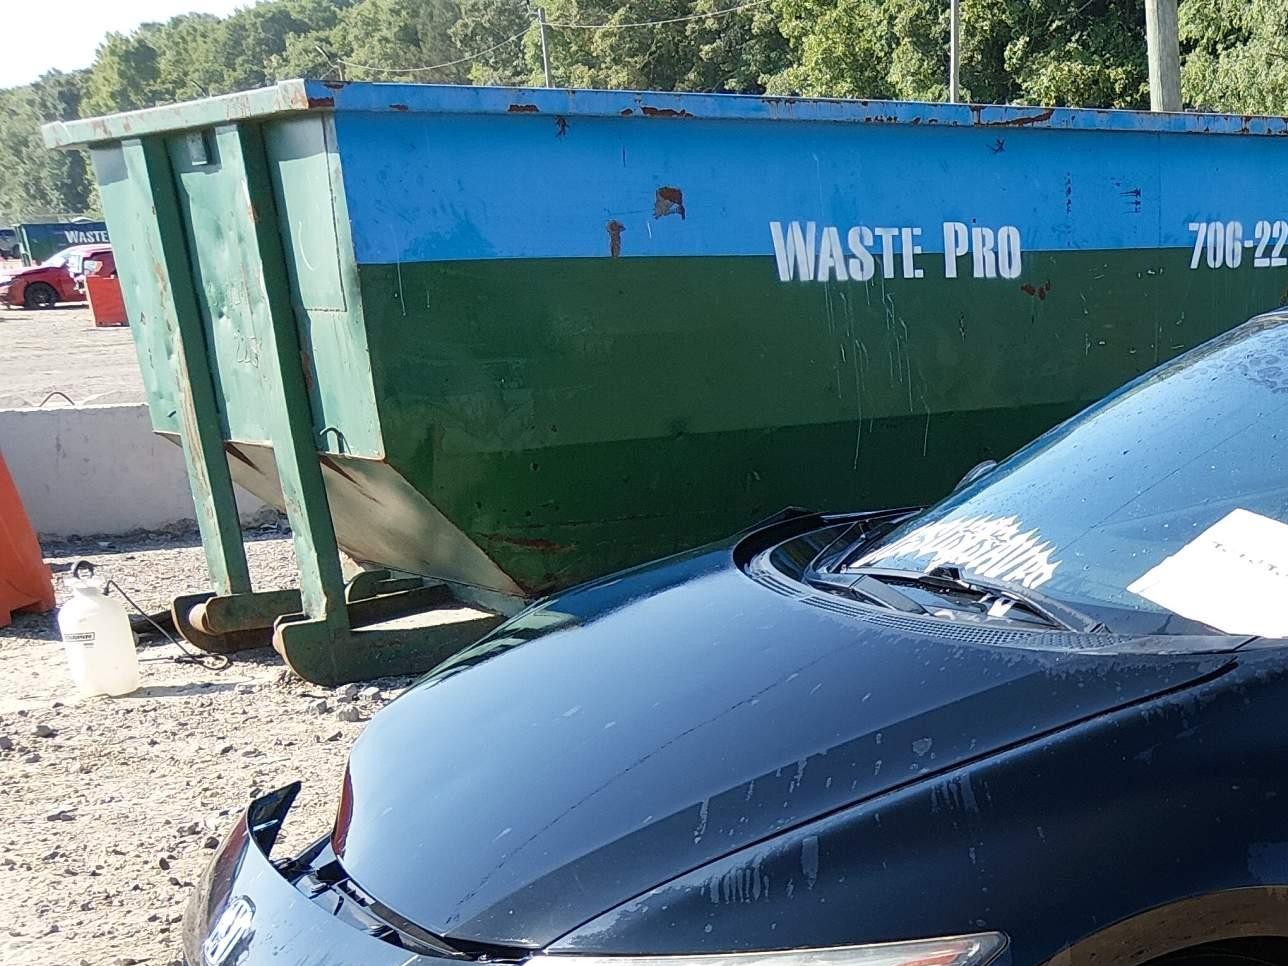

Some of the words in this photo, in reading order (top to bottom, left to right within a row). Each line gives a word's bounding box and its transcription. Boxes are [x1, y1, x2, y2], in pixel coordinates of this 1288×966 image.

[64, 230, 109, 244] WASTE
[769, 221, 924, 282] WASTE
[943, 221, 1022, 280] PRO
